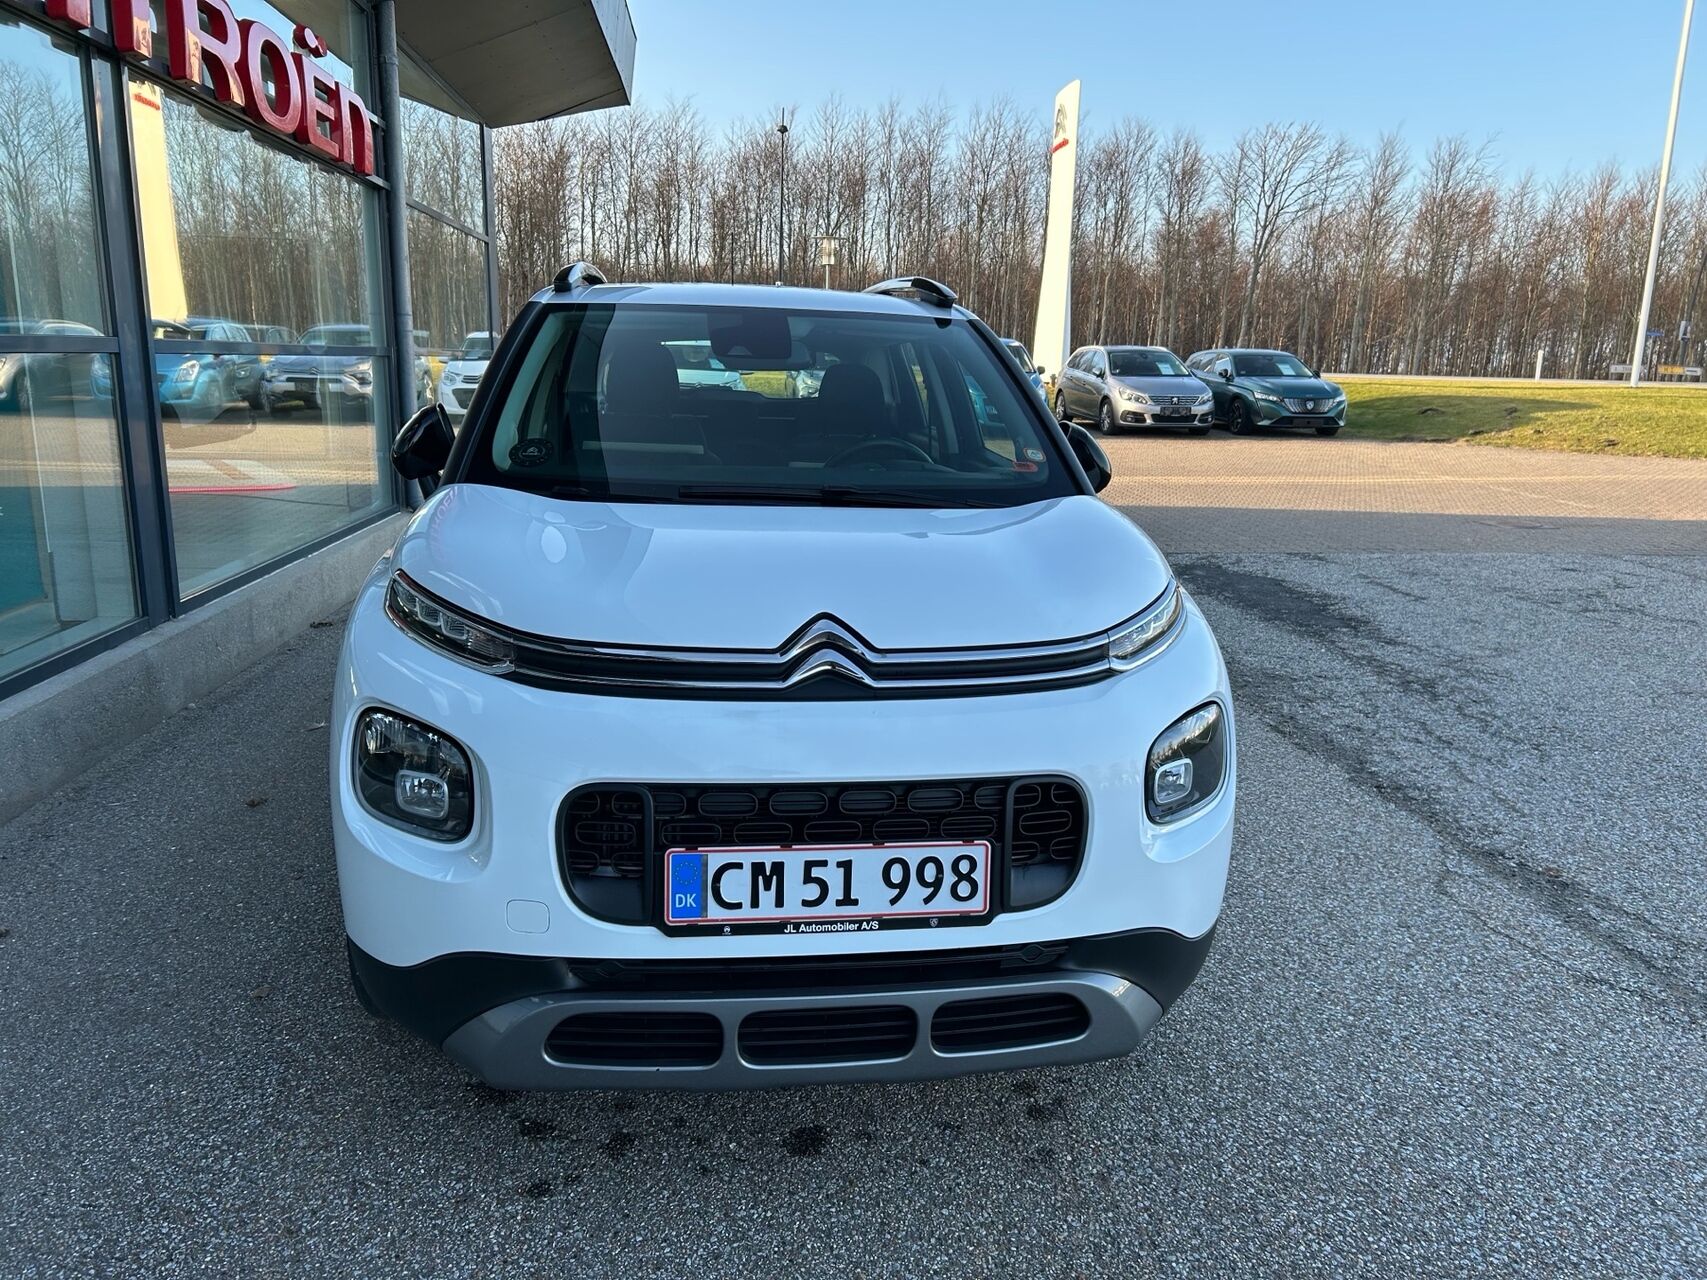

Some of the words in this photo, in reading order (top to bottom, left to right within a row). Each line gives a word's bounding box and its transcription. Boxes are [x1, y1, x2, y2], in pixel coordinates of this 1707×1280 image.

[710, 860, 785, 911] CM
[801, 858, 860, 908] 51
[881, 853, 979, 907] 998
[675, 893, 697, 909] DK
[783, 924, 797, 934] JL
[798, 922, 859, 933] Automobiler
[860, 920, 879, 931] A/S
